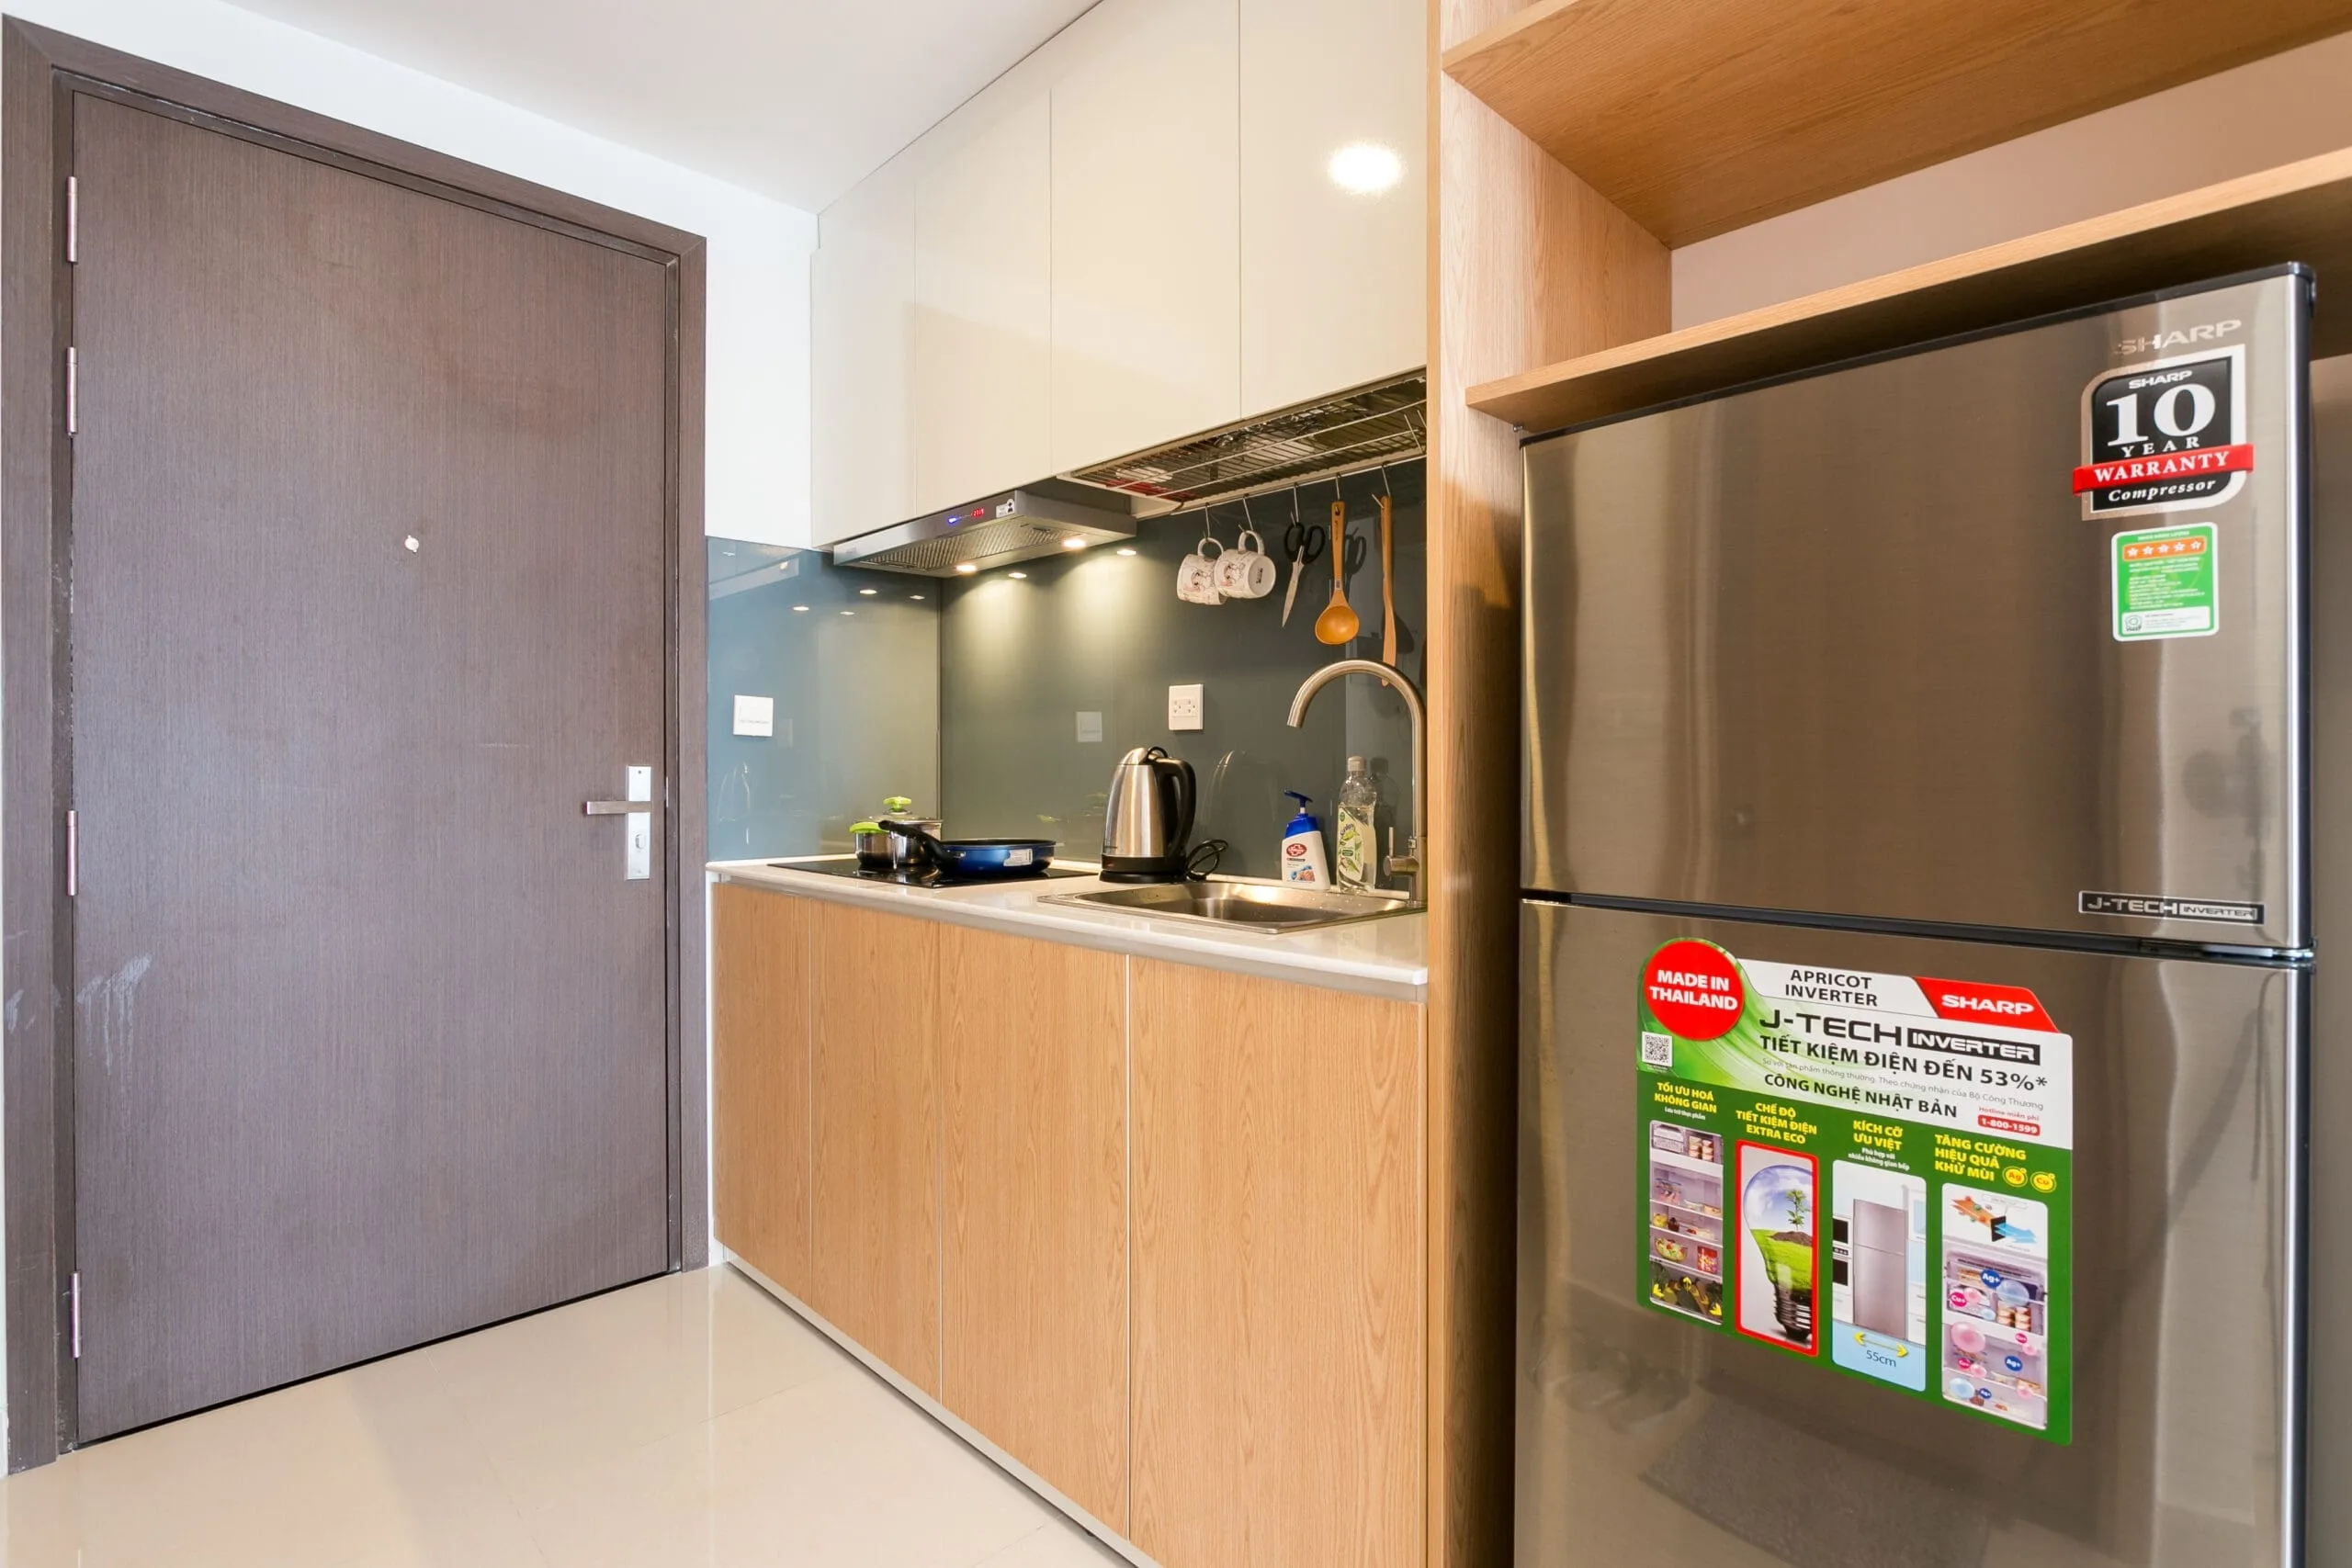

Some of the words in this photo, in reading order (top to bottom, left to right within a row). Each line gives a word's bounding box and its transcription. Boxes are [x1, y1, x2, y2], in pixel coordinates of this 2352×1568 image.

[2114, 319, 2243, 355] SHARP
[2128, 370, 2193, 389] SHARP
[2106, 383, 2216, 446] 10
[2121, 436, 2200, 458] YEAR
[2094, 451, 2230, 483] WARRANTY
[2108, 480, 2216, 502] Compressor
[2086, 897, 2178, 915] J-TECH
[2183, 906, 2256, 919] INVERTER
[1657, 969, 1708, 989] MADE
[1710, 976, 1729, 991] IN
[1790, 969, 1872, 989] APRICOT
[1649, 986, 1738, 1010] THAILAND
[1785, 984, 1878, 1007] INVERTER
[1941, 994, 2035, 1015] SHARP
[1758, 1009, 1902, 1046] J-TECH
[1912, 1032, 2035, 1061] INVERTER
[1759, 1033, 1801, 1055] TIẾT
[1806, 1043, 1858, 1066] KIỆM
[1863, 1051, 1917, 1075] ĐIỆN
[1924, 1058, 1973, 1082] ĐẾN
[1657, 1082, 1673, 1093] TỐI
[1675, 1085, 1690, 1096] ƯU
[1691, 1089, 1714, 1101] HOÁ
[1764, 1073, 1810, 1092] CÔNG
[1814, 1082, 1860, 1104] NGHỆ
[1865, 1090, 1914, 1111] NHẬT
[1918, 1098, 1957, 1118] BẢN
[1822, 1067, 1846, 1079] thông
[1879, 1076, 1898, 1086] Theo
[1982, 1093, 2007, 1105] Công
[1654, 1092, 1690, 1108] KHÔNG
[1691, 1101, 1717, 1113] GIAN
[1755, 1102, 1777, 1115] CHẾ
[1779, 1105, 1797, 1120] ĐỘ
[1978, 1105, 2005, 1116] Hotline
[1736, 1110, 1758, 1122] TIẾT
[1759, 1115, 1788, 1129] KIỆM
[1789, 1121, 1817, 1135] ĐIỆN
[1853, 1120, 1883, 1134] KÍCH
[1981, 1117, 2038, 1134] 1-800-1599
[1746, 1123, 1781, 1140] EXTRA
[1783, 1131, 1806, 1145] ECO
[1853, 1132, 1872, 1145] ƯU
[1873, 1136, 1903, 1151] VIỆT
[1934, 1134, 1972, 1150] TĂNG
[1973, 1141, 2027, 1160] CƯỜNG
[1934, 1146, 1967, 1163] HIỆU
[1969, 1153, 2000, 1169] QUẢ
[1934, 1160, 1965, 1175] KHỬ
[1967, 1167, 1995, 1181] MÙI
[1982, 1272, 2000, 1283] Ag+
[1866, 1349, 1896, 1368] 55cm
[2006, 1359, 2021, 1368] Ag+
